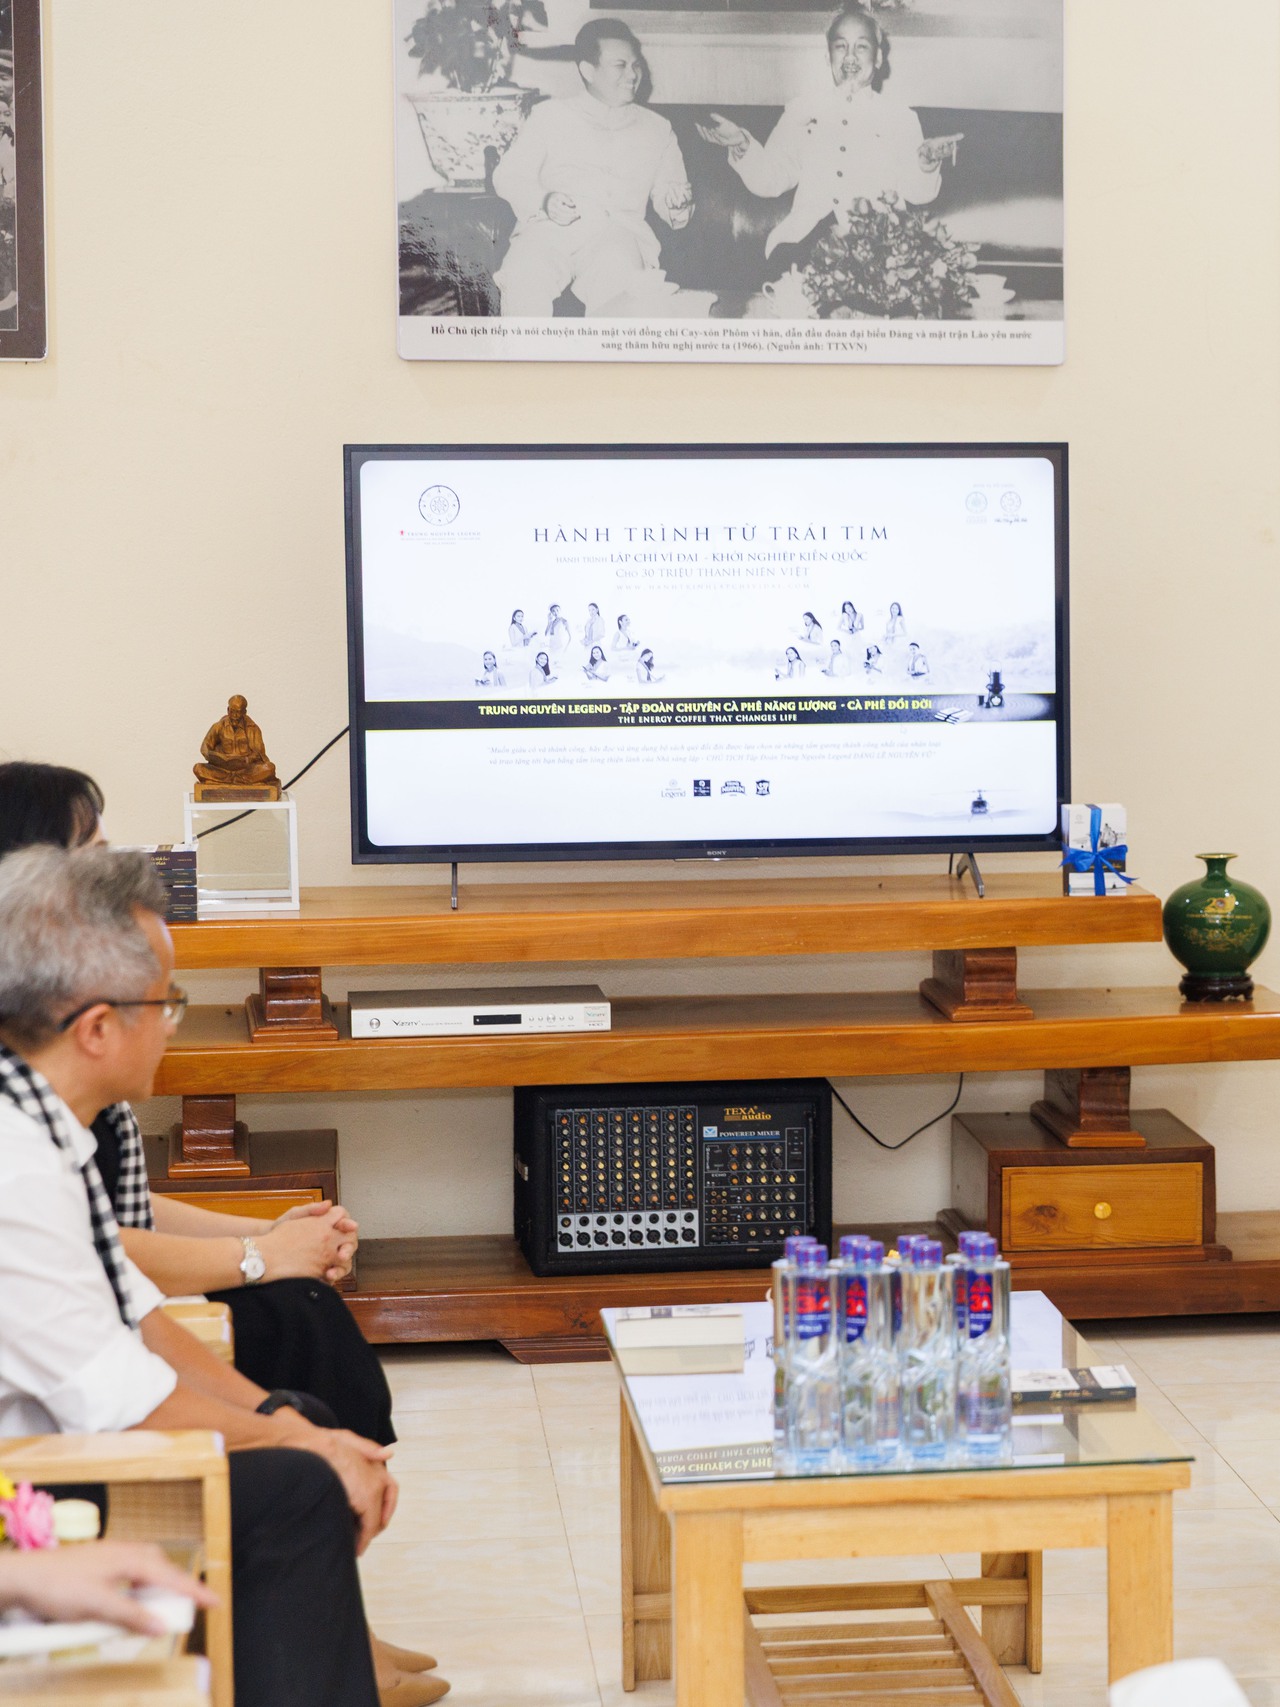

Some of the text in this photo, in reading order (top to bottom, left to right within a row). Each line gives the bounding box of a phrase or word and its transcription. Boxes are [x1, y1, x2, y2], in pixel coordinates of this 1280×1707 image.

[431, 324, 445, 335] Hồ
[447, 326, 468, 335] Chủ
[470, 326, 488, 337] tịch
[490, 324, 508, 337] tiếp
[511, 327, 522, 335] và
[525, 327, 539, 335] nói
[541, 327, 575, 338] chuyện
[577, 327, 599, 336] thân
[601, 328, 619, 338] mật
[622, 328, 636, 336] với
[639, 326, 662, 338] đồng
[664, 328, 678, 337] chí
[785, 327, 802, 337] dẫn
[805, 327, 822, 337] đầu
[825, 328, 847, 338] đoàn
[850, 329, 864, 340] đại
[867, 327, 886, 338] biểu
[889, 329, 913, 340] Đảng
[916, 329, 926, 338] và
[949, 330, 968, 341] trận
[971, 330, 989, 339] Lào
[991, 330, 1007, 341] yêu
[1010, 330, 1032, 339] nước
[601, 342, 622, 351] sang
[625, 341, 649, 349] thăm
[652, 341, 670, 349] hữu
[672, 341, 693, 352] nghị
[695, 341, 718, 350] nước
[721, 342, 730, 350] ta
[767, 340, 800, 352] (Nguồn
[827, 342, 868, 352] TTXVN)
[534, 522, 888, 543] HÀNH TRÌNH TỪ TRÁI TIM
[642, 569, 655, 578] 30
[698, 567, 741, 577] THANH
[746, 567, 776, 577] NIÊN
[781, 566, 810, 577] VIỆT
[478, 705, 517, 715] TRUNG
[520, 703, 565, 715] NGUYÊN
[568, 704, 612, 714] LEGEND
[619, 702, 639, 715] TẬP
[642, 701, 674, 713] ĐOÀN
[676, 701, 720, 712] CHUYÊN
[723, 700, 738, 712] CÀ
[741, 700, 762, 711] PHÊ
[764, 700, 795, 711] NĂNG
[798, 700, 837, 712] LƯỢNG
[847, 698, 862, 711] CÀ
[865, 698, 885, 710] PHÊ
[911, 698, 932, 709] ĐỜI
[618, 713, 797, 724] THE ENERGY COFFEE THAT CHANGES LIFE
[724, 1107, 756, 1115] TEXA
[741, 1112, 771, 1120] audio
